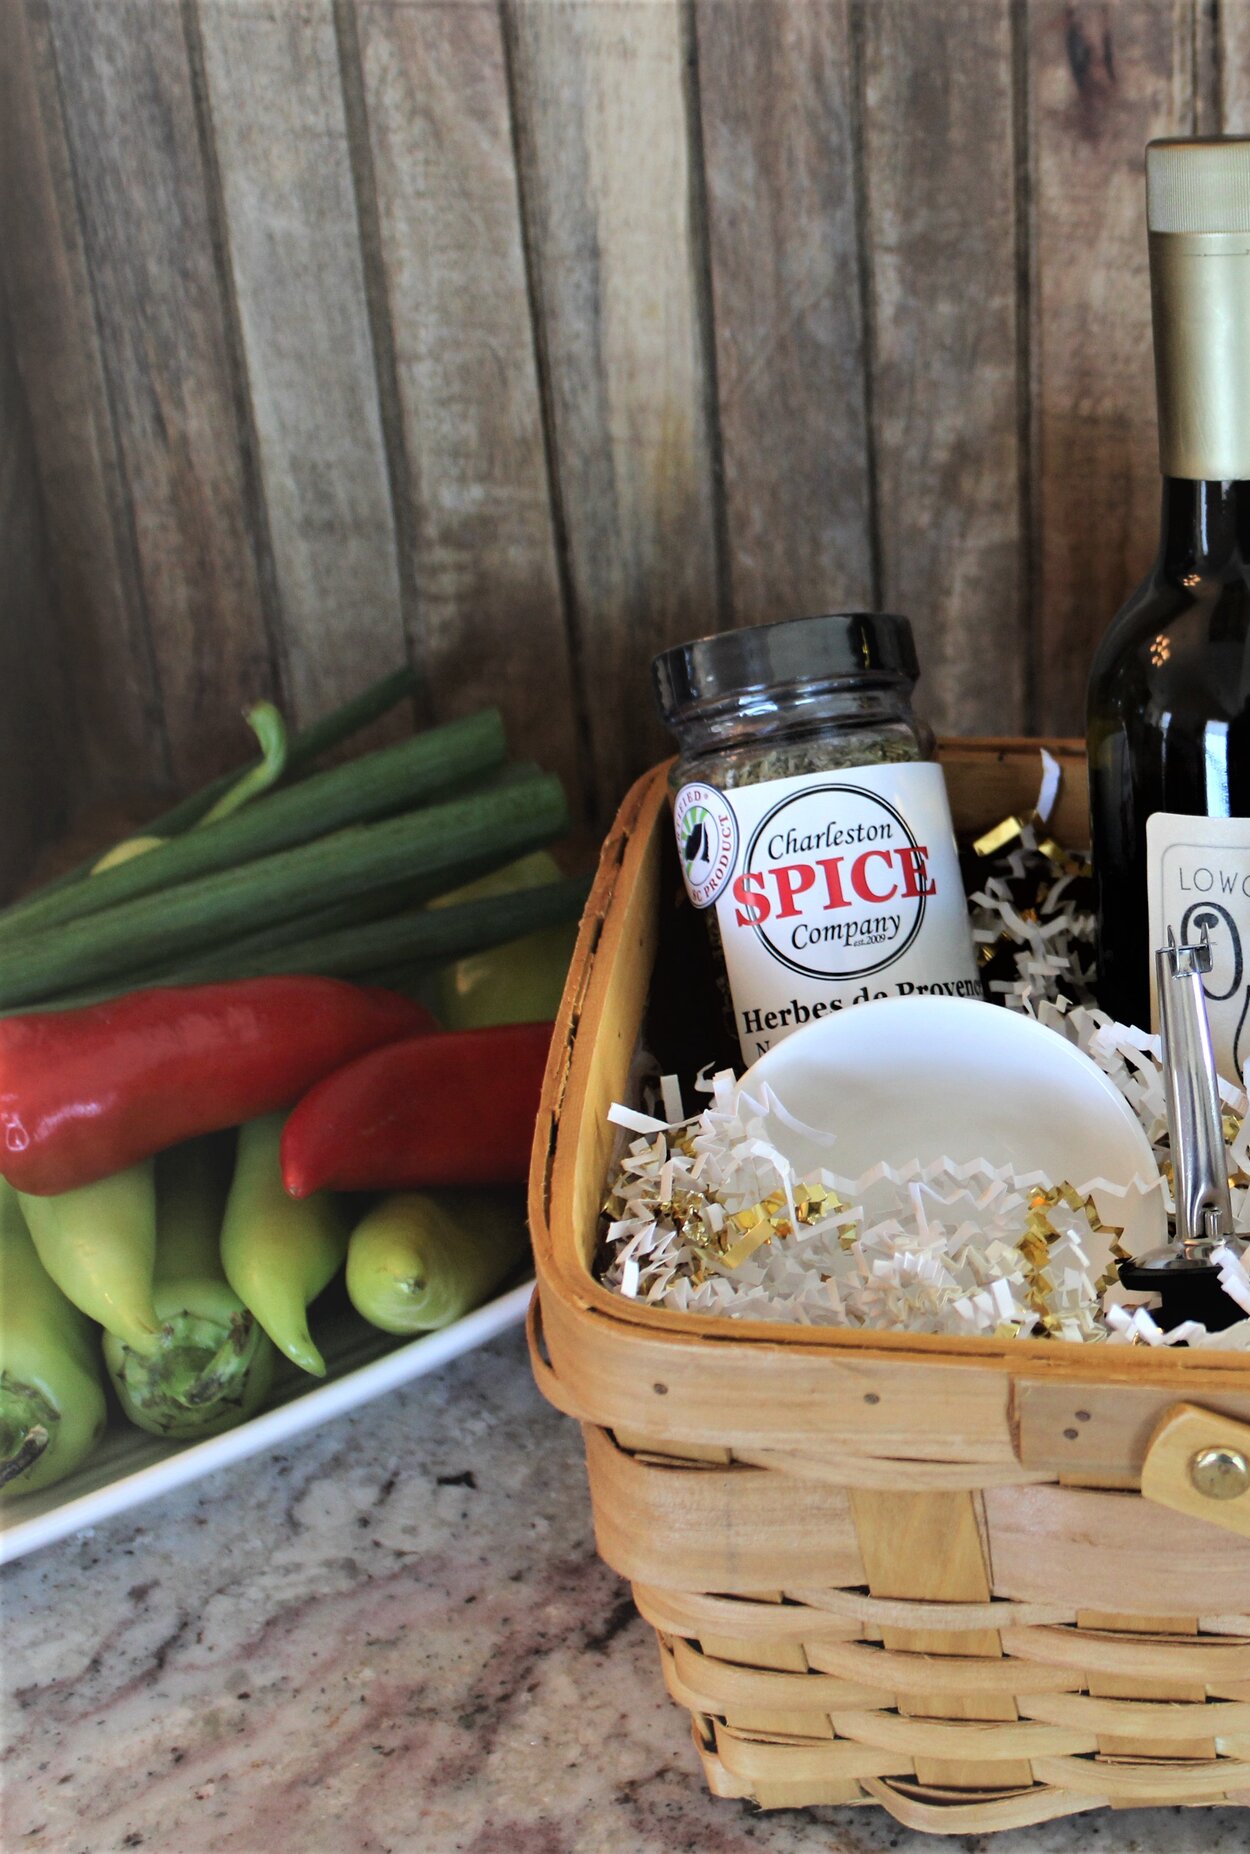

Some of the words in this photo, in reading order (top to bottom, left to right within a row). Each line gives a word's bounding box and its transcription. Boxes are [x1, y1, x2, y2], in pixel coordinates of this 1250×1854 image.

[703, 814, 731, 898] PRODUCT
[768, 821, 893, 860] Charleston
[732, 846, 937, 928] SPICE
[791, 913, 901, 950] Company
[742, 999, 843, 1034] Herbes
[895, 978, 983, 997] Provenc
